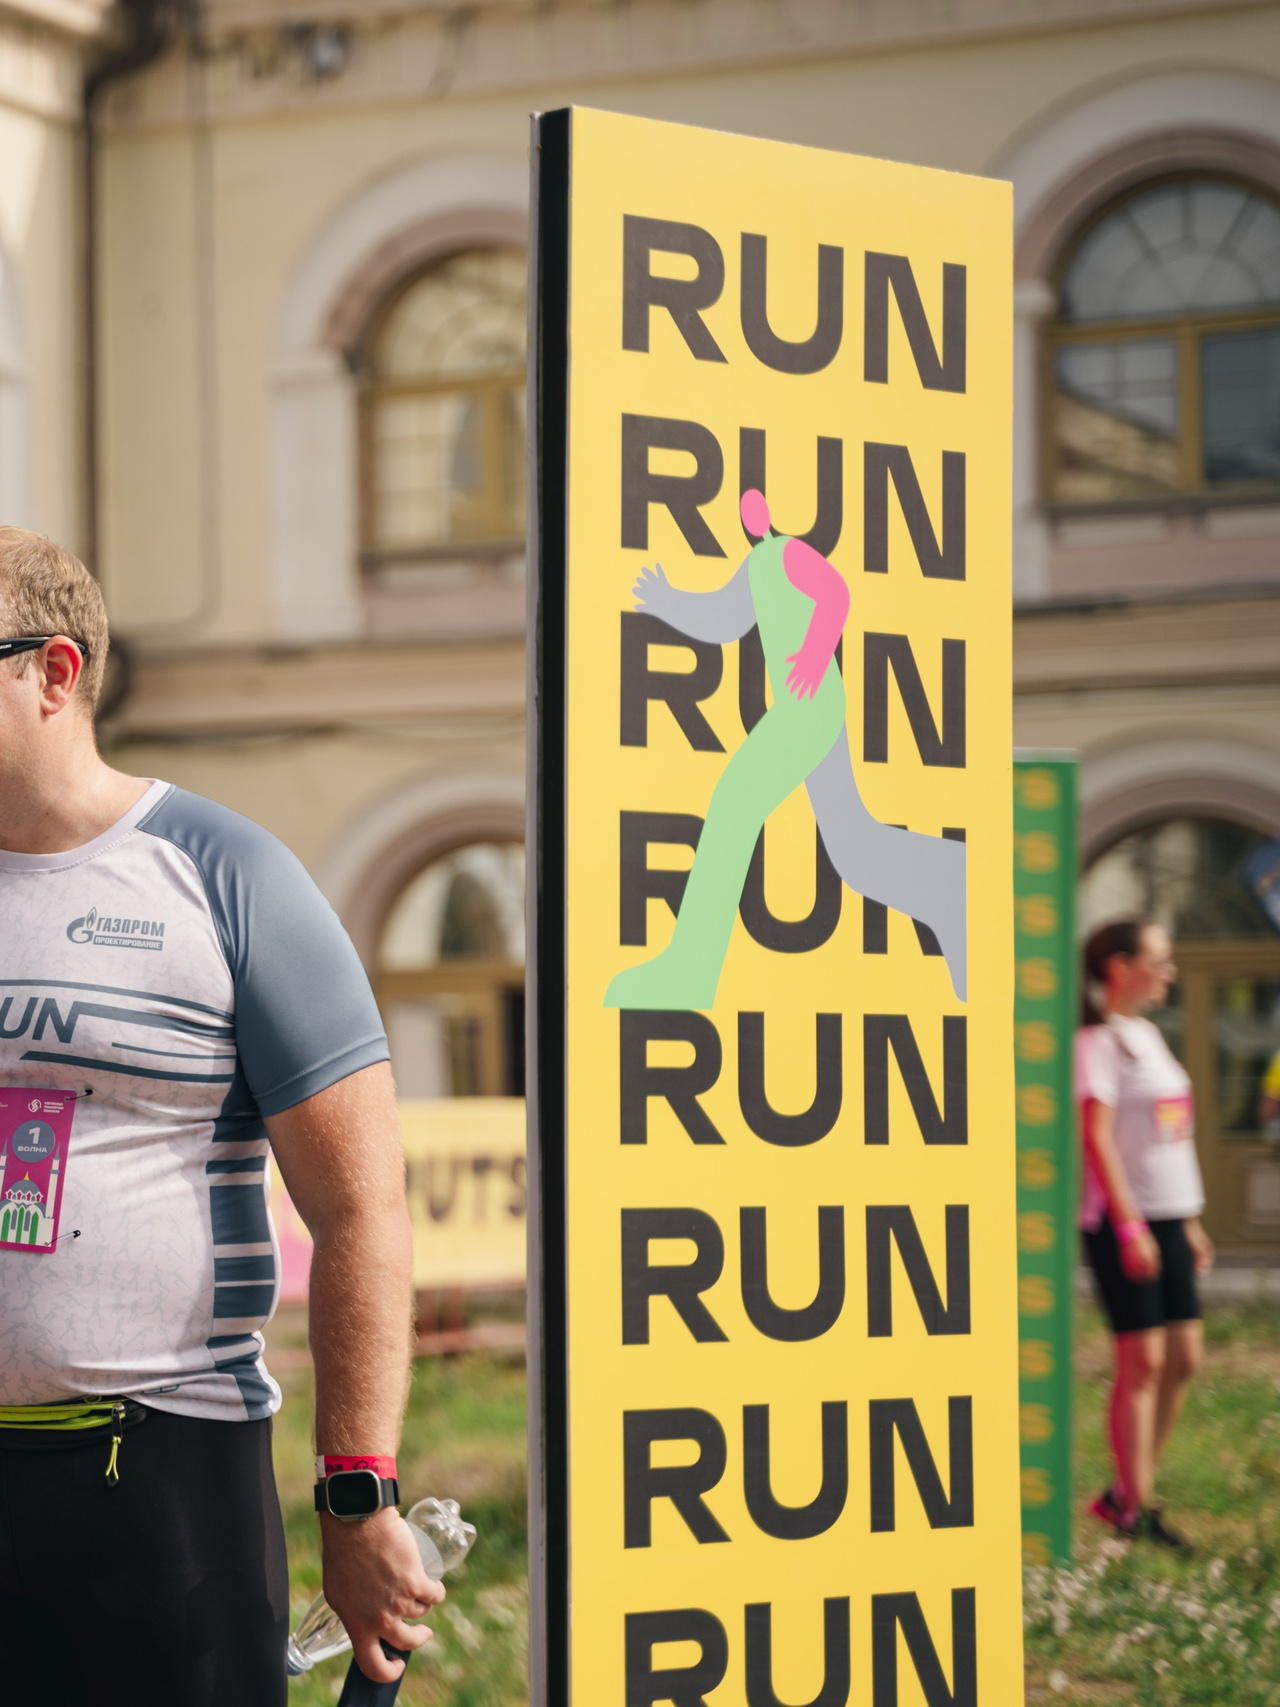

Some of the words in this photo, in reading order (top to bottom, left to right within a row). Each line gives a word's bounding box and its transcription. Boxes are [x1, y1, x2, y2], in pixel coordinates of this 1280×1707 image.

[622, 213, 967, 394] RUN
[621, 412, 967, 582] RUN
[620, 610, 967, 769] RN
[94, 936, 163, 951] ПРОЕКТИРОВАНИЕ
[96, 917, 166, 937] ГАЗПРОМ
[619, 809, 967, 958] RU
[28, 1127, 41, 1145] 1
[620, 1009, 969, 1147] RUN
[17, 1145, 48, 1154] ВОЛНА
[404, 1155, 526, 1224] UTS
[621, 1204, 971, 1345] RUN
[623, 1395, 974, 1549] RUN
[624, 1587, 977, 1707] RUN
